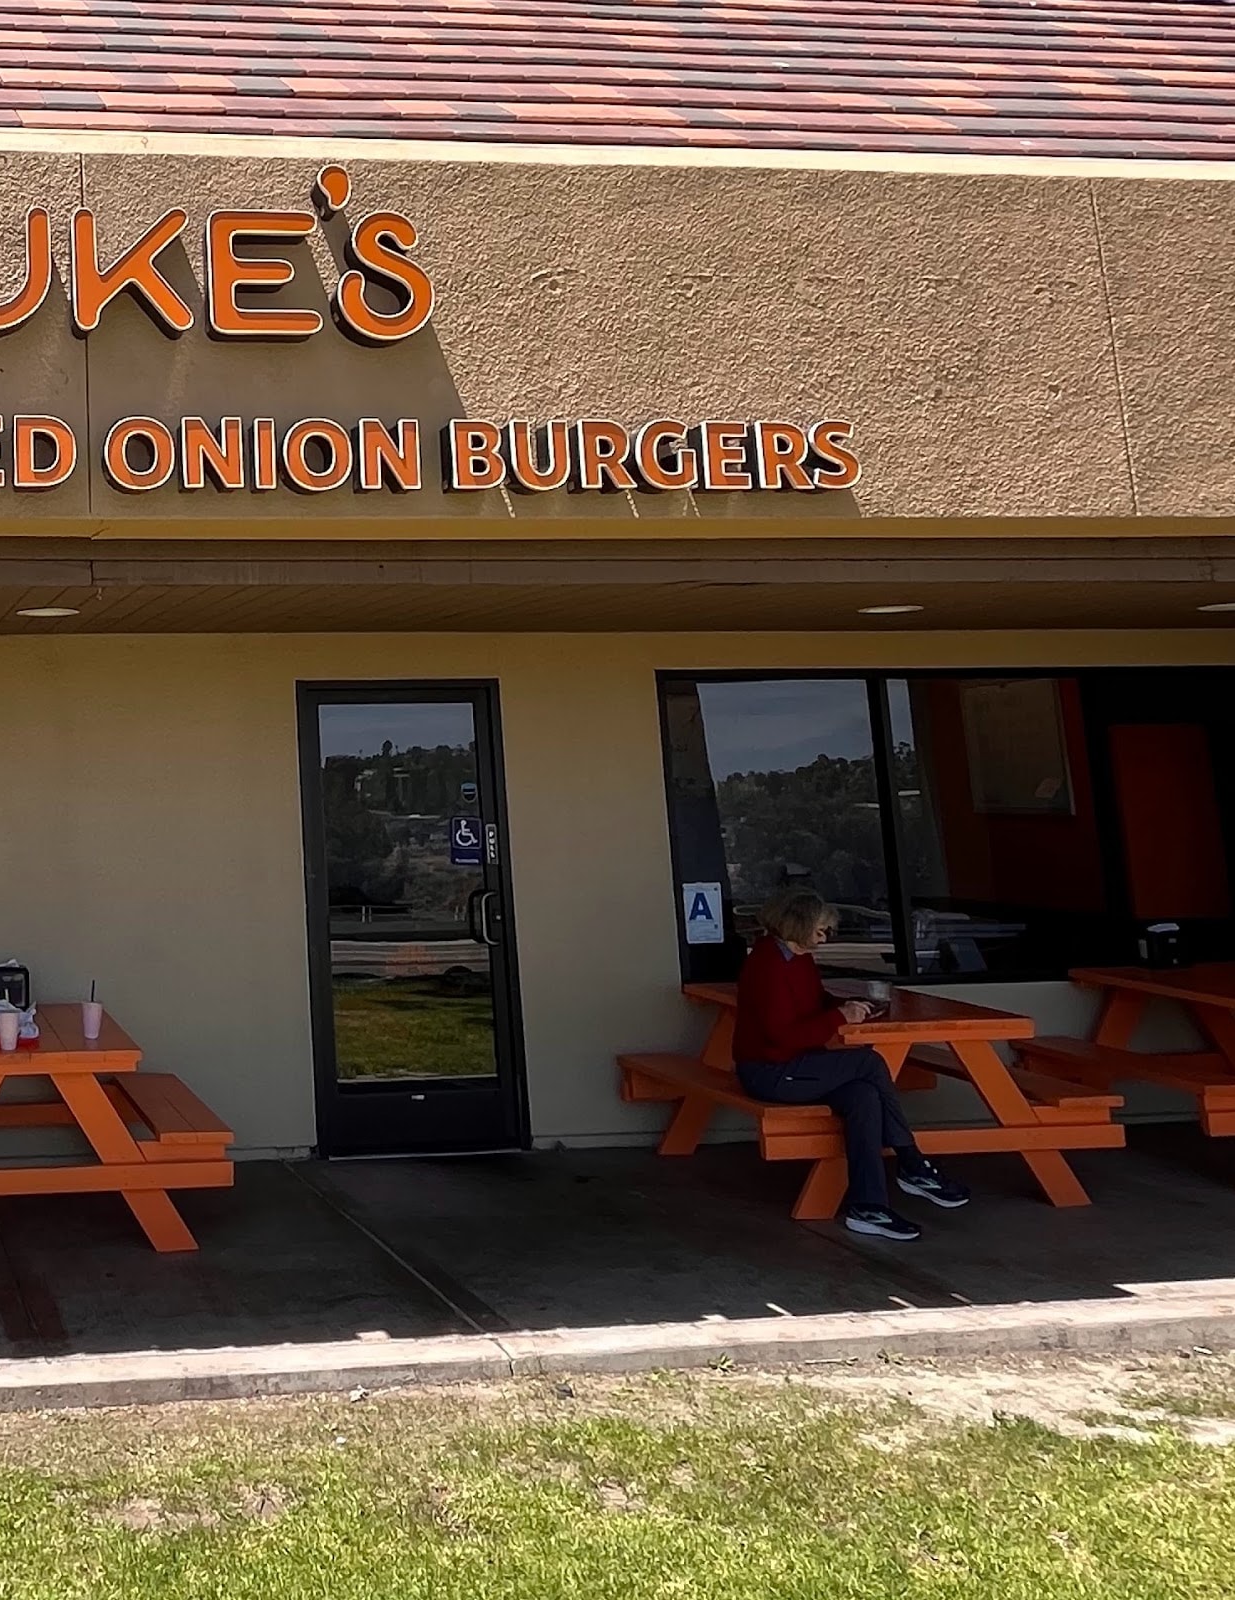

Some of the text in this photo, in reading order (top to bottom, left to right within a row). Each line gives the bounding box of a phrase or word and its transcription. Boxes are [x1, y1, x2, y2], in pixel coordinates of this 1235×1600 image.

[104, 416, 421, 490] ONION
[446, 419, 862, 491] BURGERS
[689, 893, 713, 920] A
